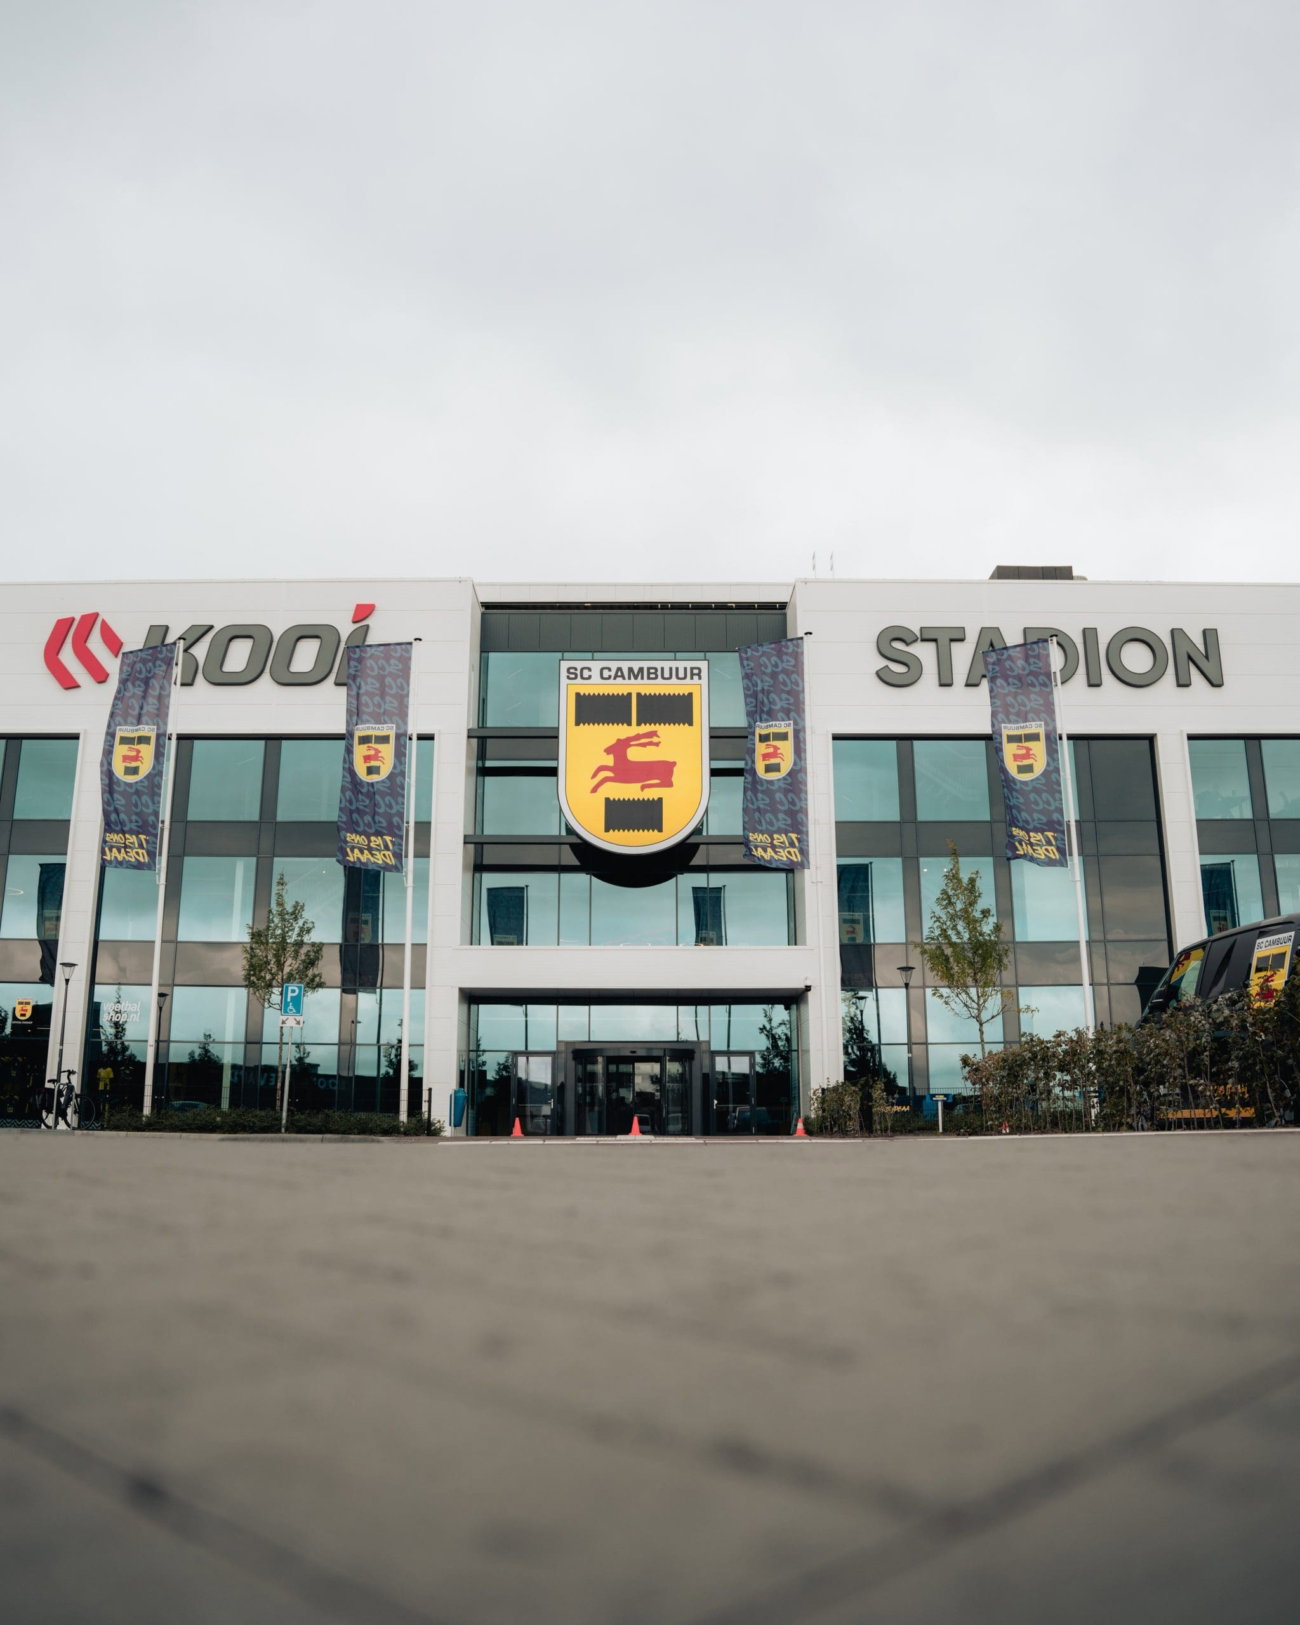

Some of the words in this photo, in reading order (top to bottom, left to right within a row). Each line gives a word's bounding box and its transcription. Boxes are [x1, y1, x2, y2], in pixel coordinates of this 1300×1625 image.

[876, 625, 1224, 688] STADION
[566, 667, 592, 680] SC
[600, 667, 702, 680] CAMBUUR
[287, 986, 299, 1002] P
